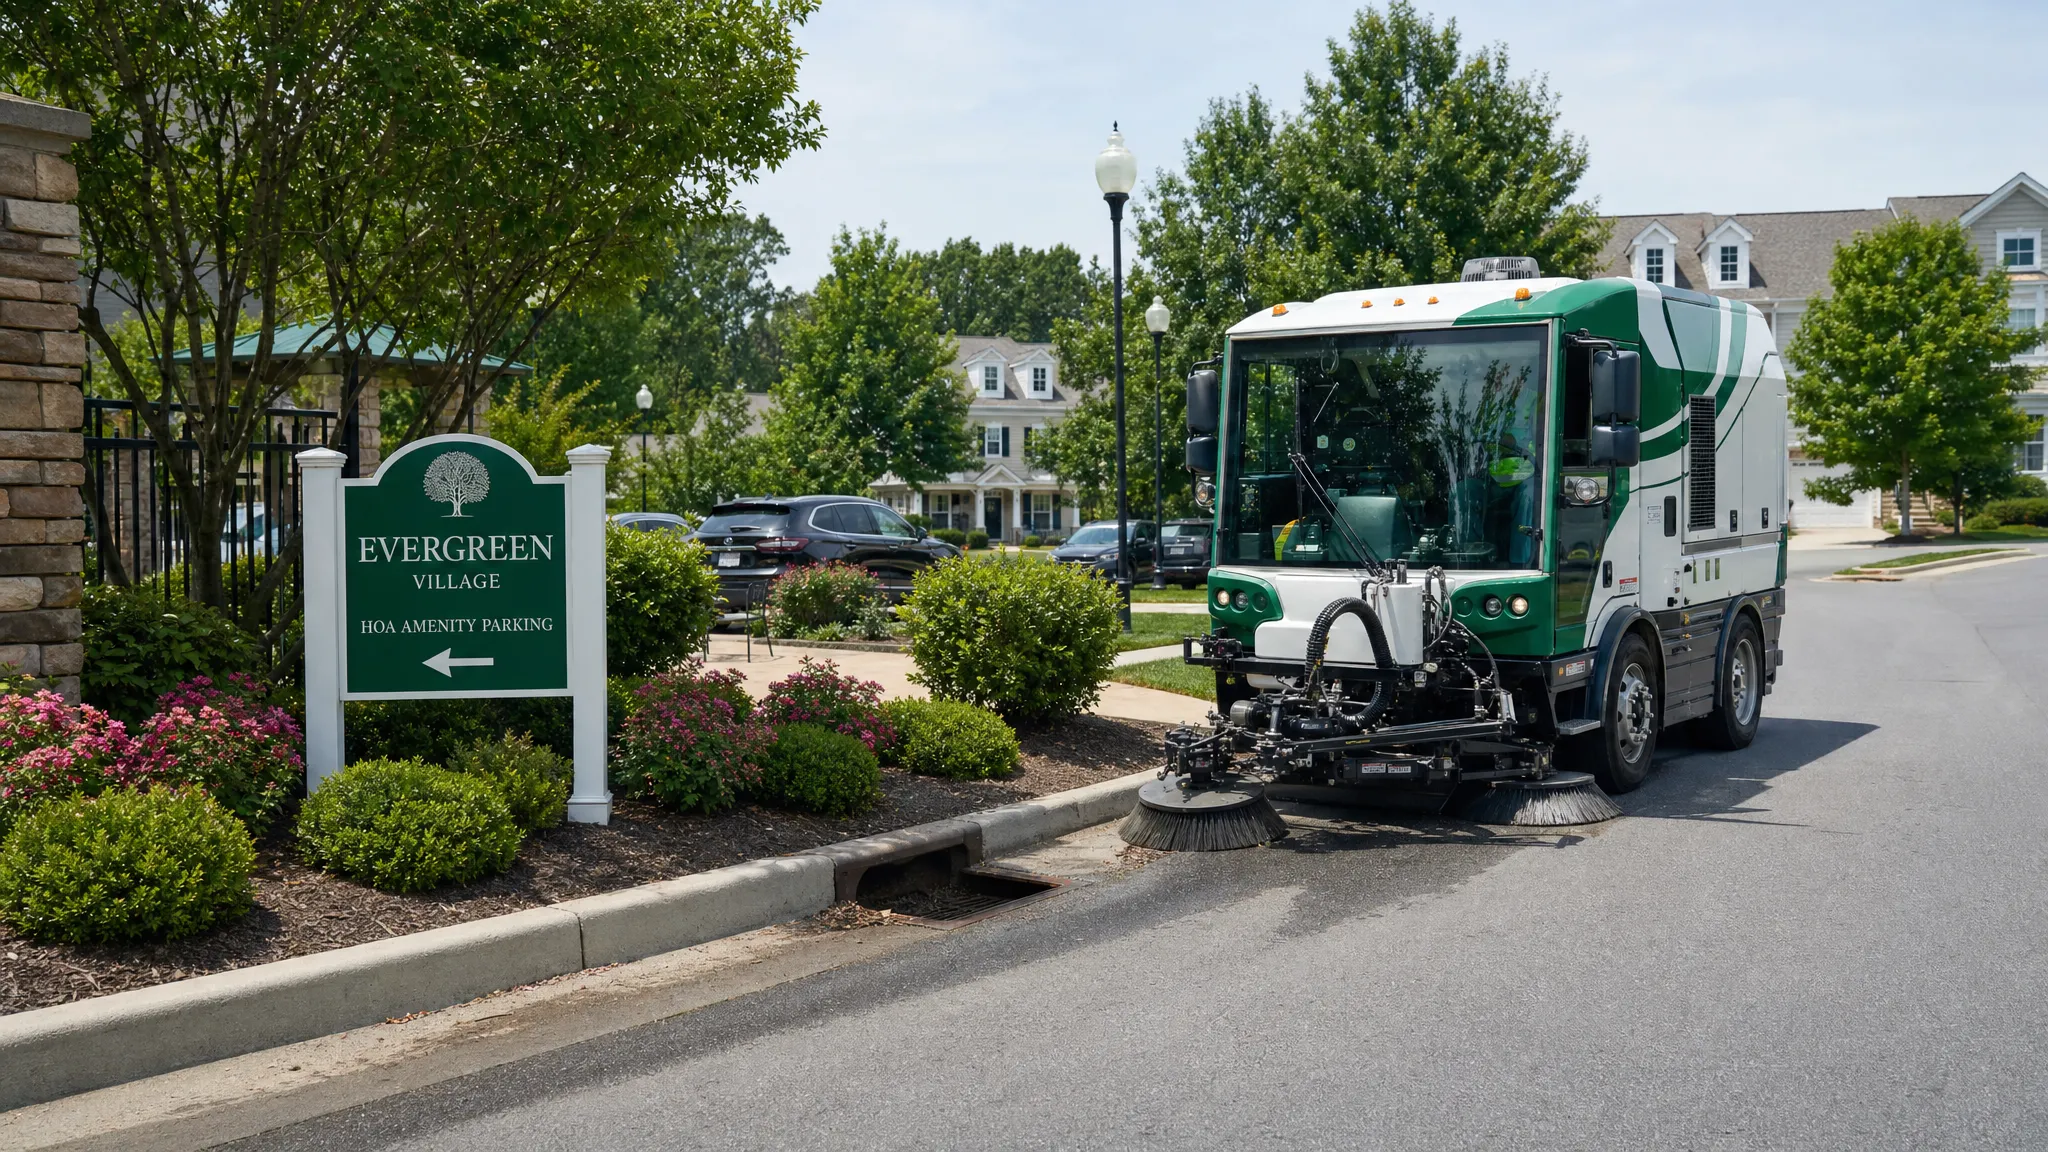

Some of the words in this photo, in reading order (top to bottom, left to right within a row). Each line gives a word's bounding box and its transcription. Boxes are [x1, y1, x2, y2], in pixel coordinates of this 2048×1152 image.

[358, 534, 554, 563] EVERGREEN
[412, 573, 501, 590] VILLAGE
[360, 619, 397, 634] HOA
[400, 618, 477, 634] AMENITY
[481, 617, 553, 632] PARKING
